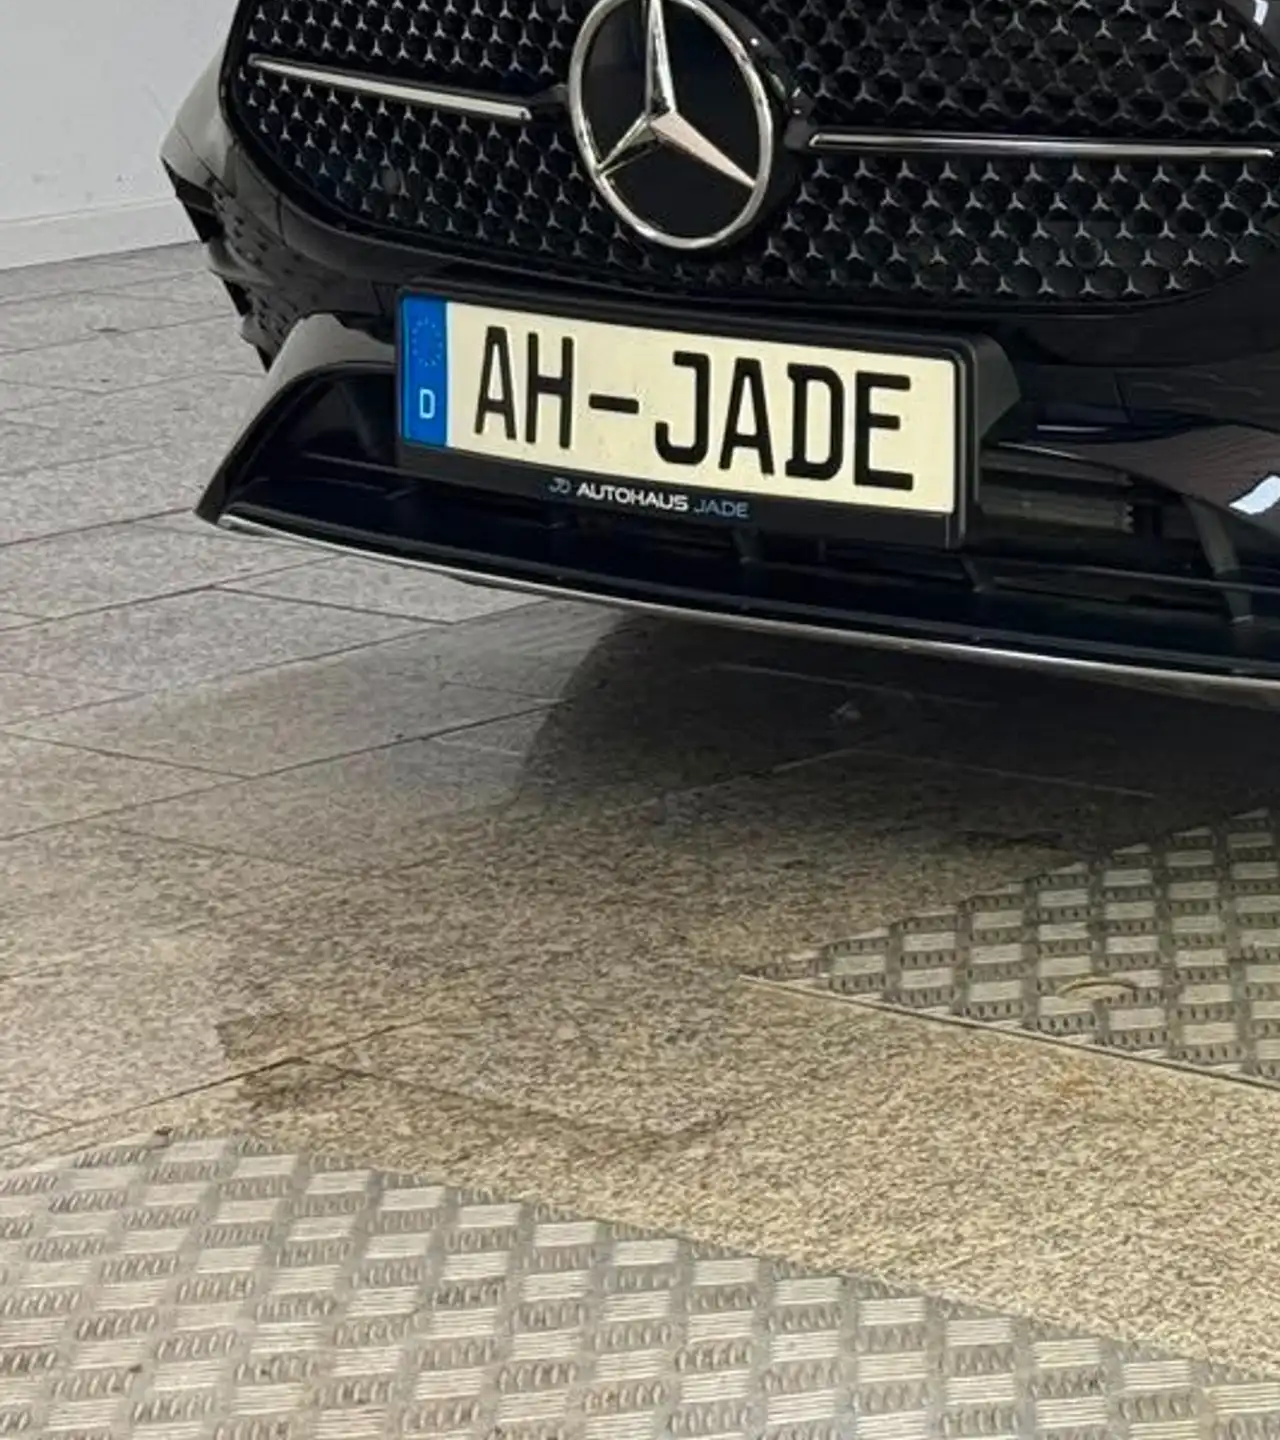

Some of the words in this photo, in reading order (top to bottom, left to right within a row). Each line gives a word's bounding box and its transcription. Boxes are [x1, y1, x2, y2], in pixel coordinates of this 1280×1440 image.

[419, 387, 436, 420] D
[474, 325, 914, 491] AH-JADE
[575, 481, 690, 513] AUTOHAUS
[693, 499, 749, 519] JADE
